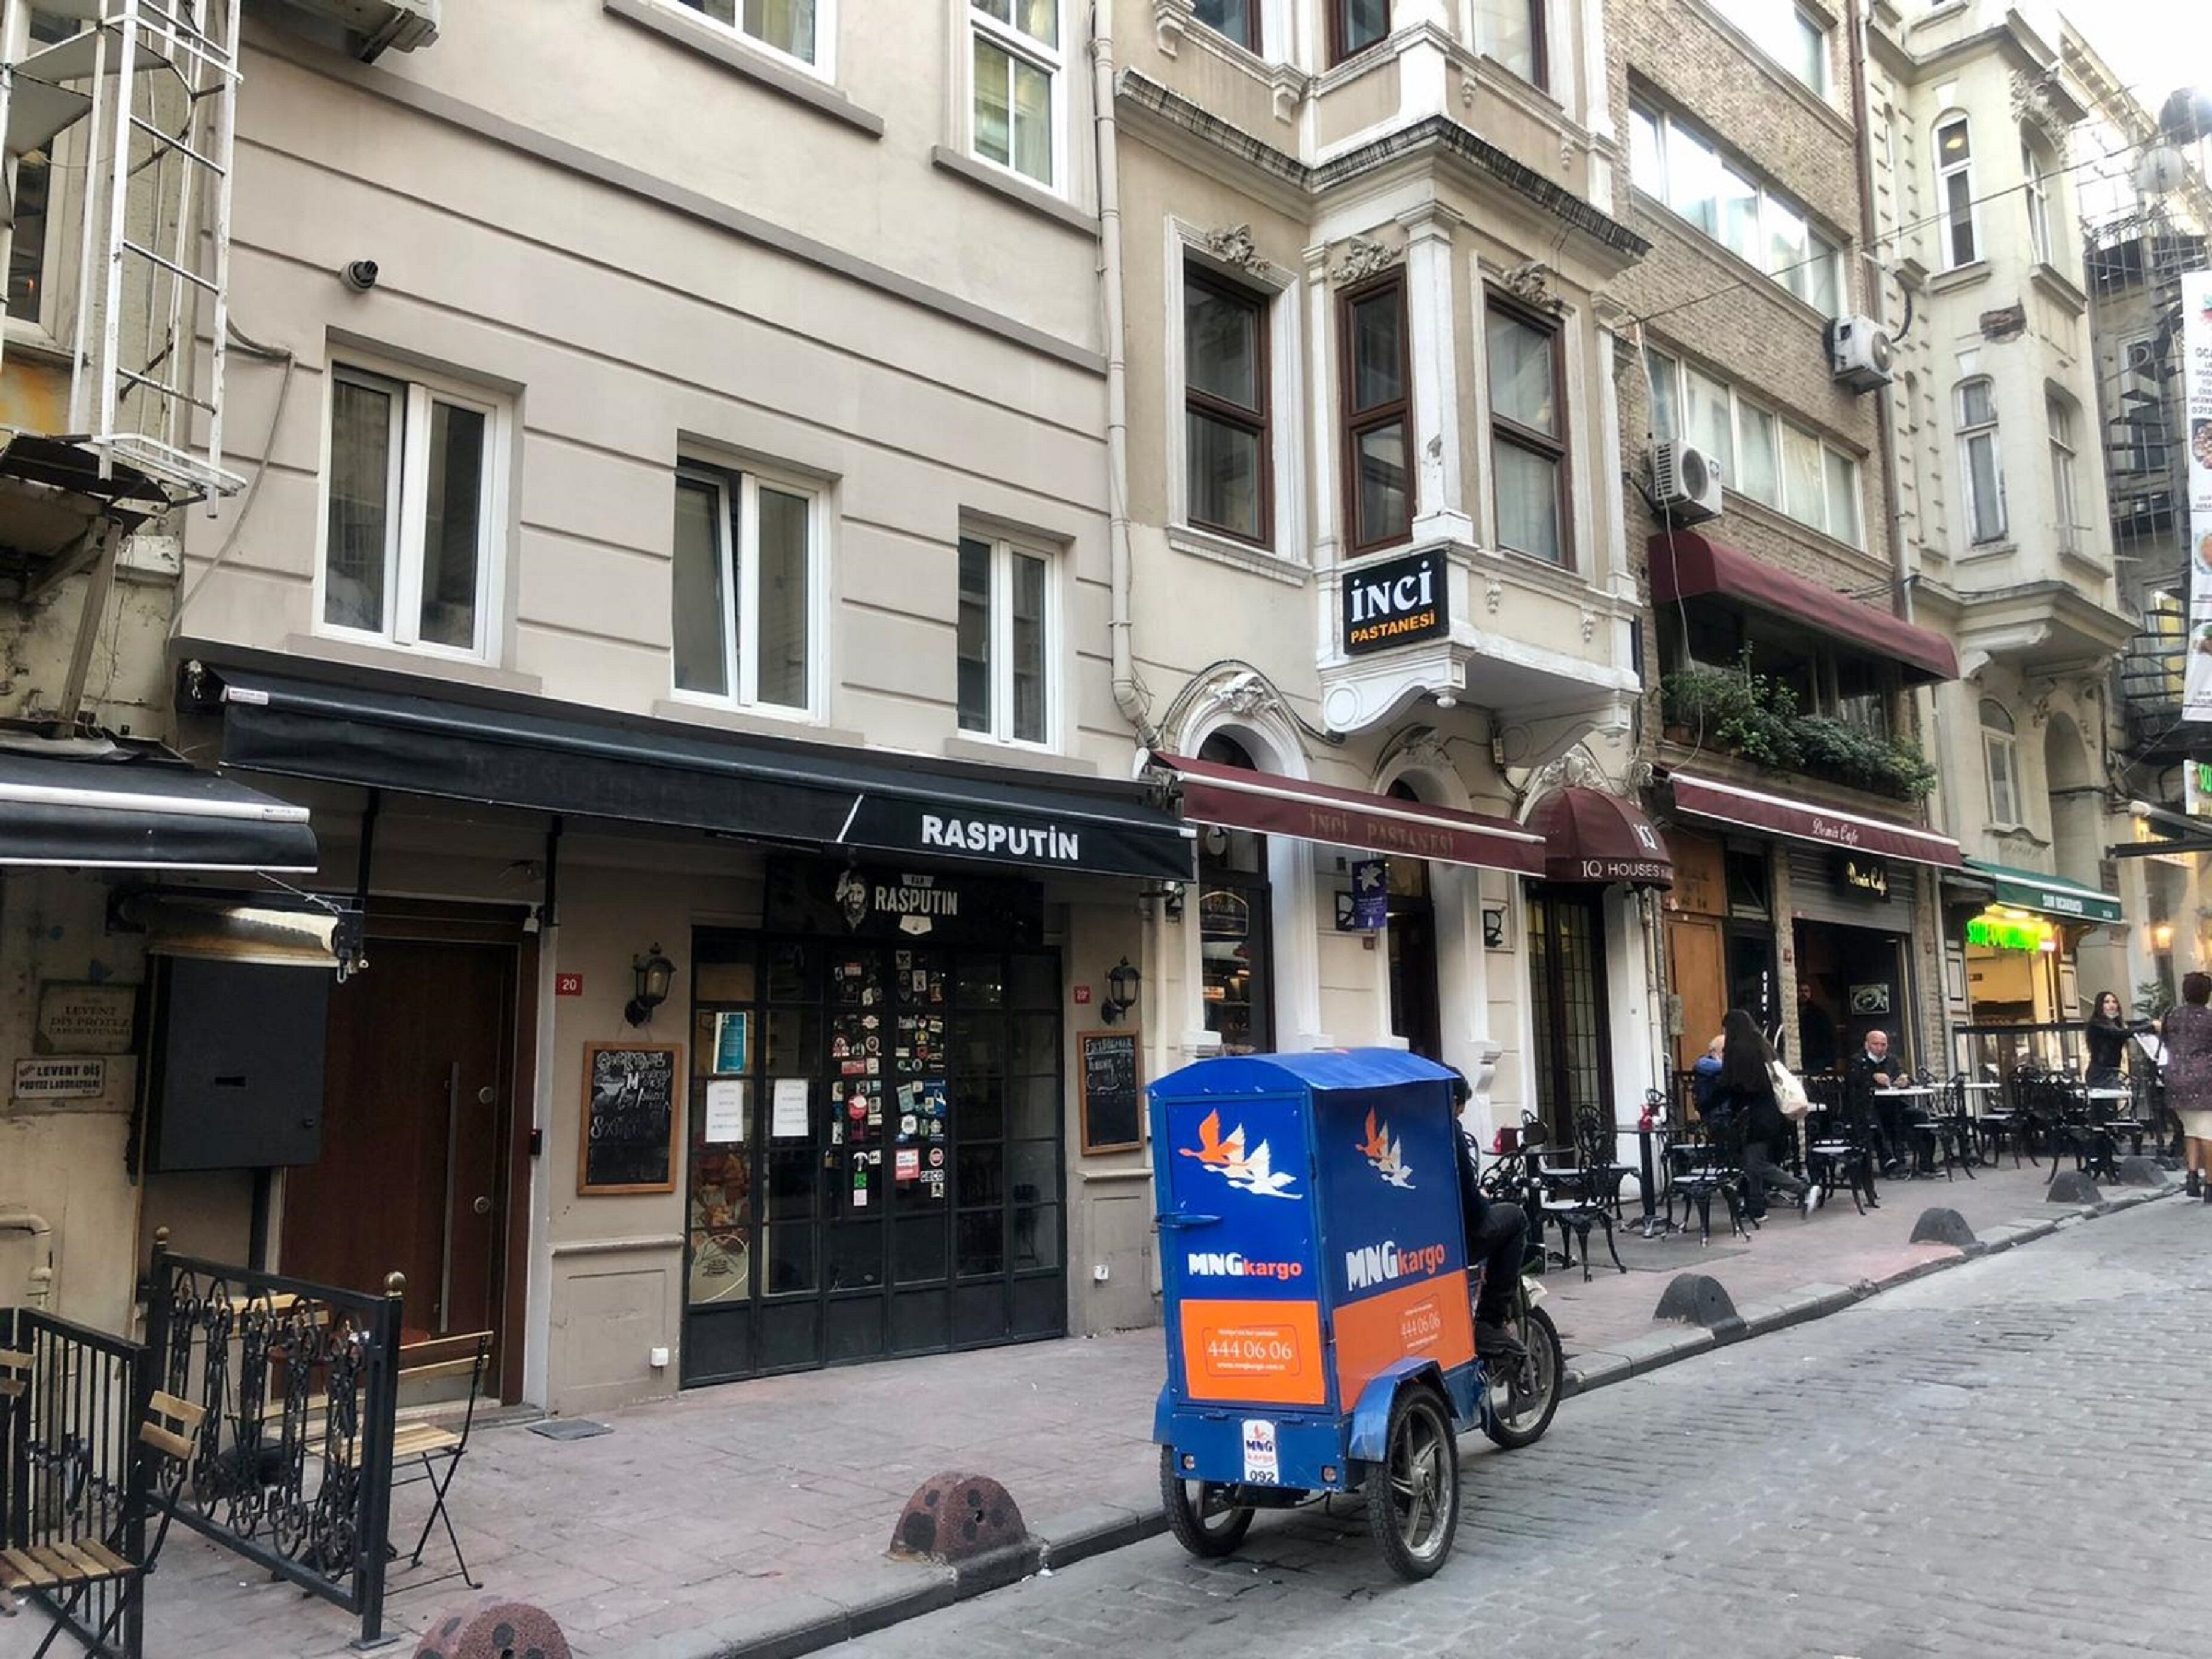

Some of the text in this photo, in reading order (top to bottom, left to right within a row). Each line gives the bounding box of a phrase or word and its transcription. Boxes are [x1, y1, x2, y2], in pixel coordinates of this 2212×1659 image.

[1351, 561, 1432, 622] İNCİ
[1351, 609, 1435, 644] PASTANESİ
[922, 815, 1078, 860] RASPUTİN
[1582, 860, 1660, 878] IQ HOUSES
[875, 885, 957, 915] RASPUTIN
[561, 979, 576, 991] 20
[37, 1065, 80, 1076] LEVENT
[1208, 1340, 1293, 1361] 444 06 06
[1246, 1440, 1274, 1452] MNG
[1250, 1470, 1275, 1484] 092
